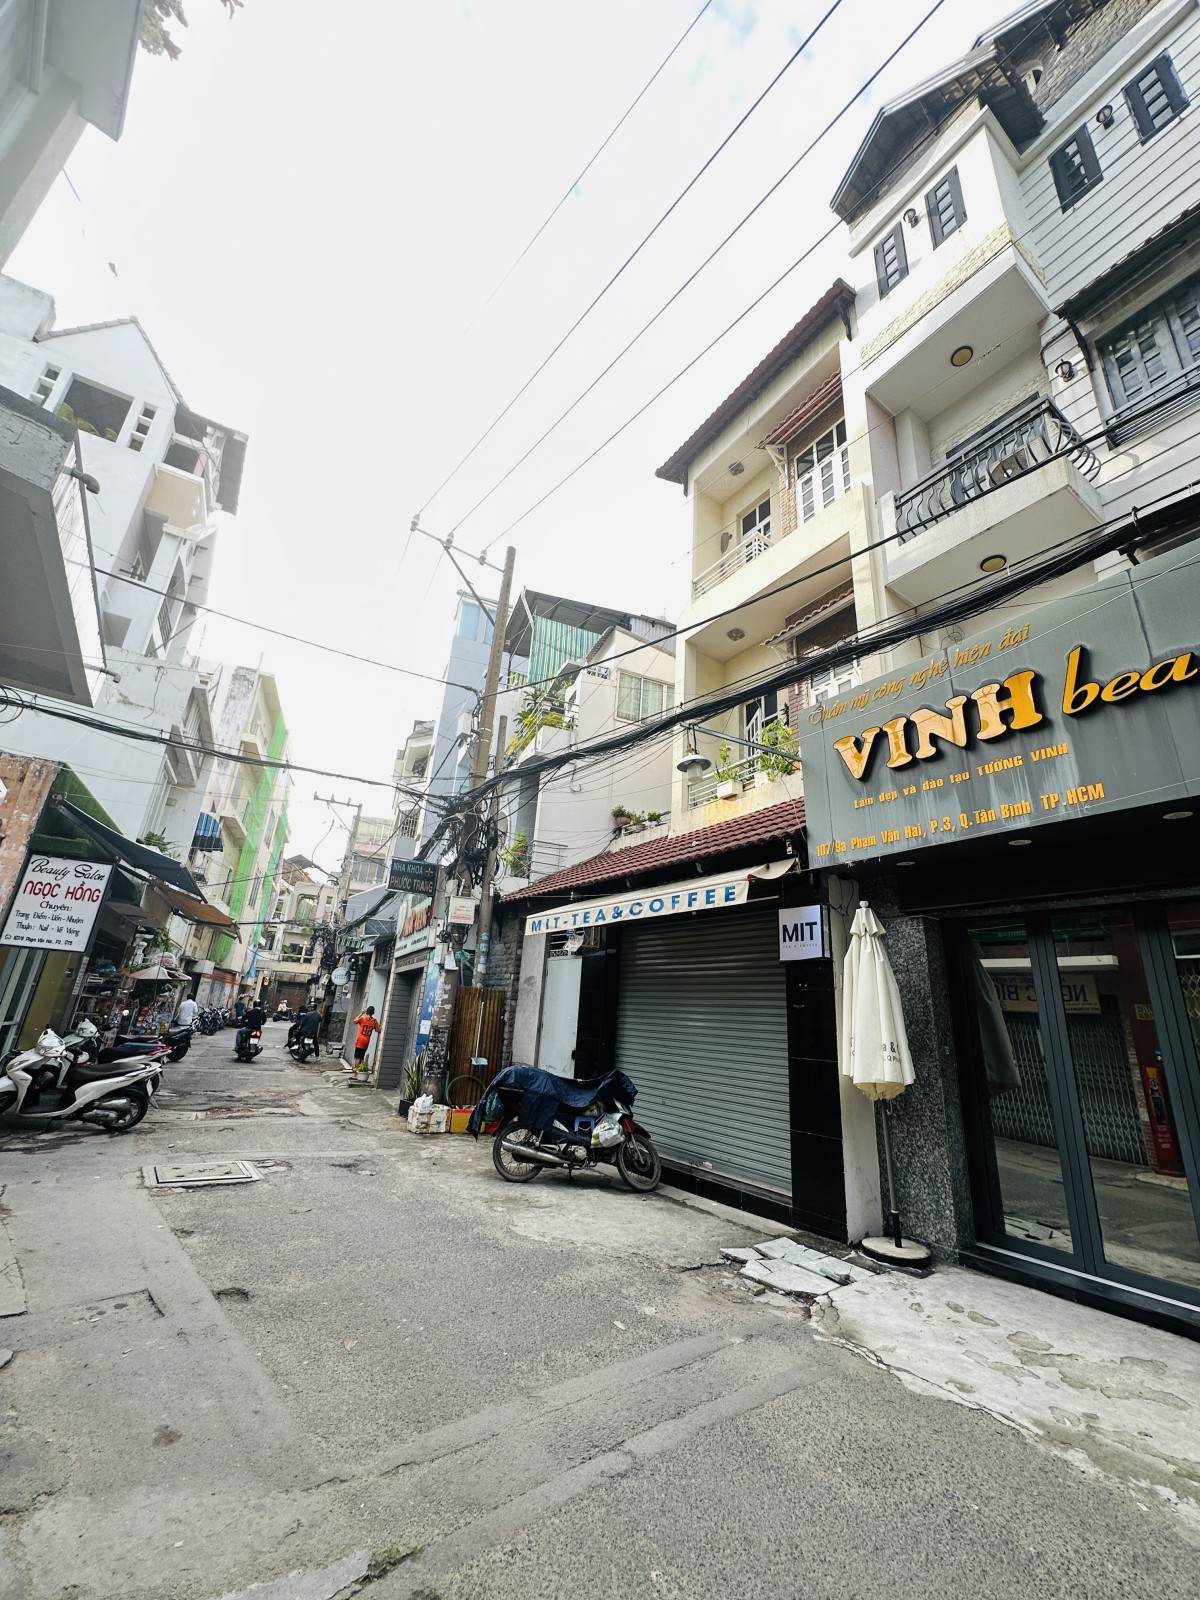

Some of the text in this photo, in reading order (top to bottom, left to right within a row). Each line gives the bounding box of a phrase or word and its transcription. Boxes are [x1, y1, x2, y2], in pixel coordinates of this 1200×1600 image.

[851, 688, 871, 712] mỹ
[872, 676, 906, 700] công
[908, 656, 949, 690] nghệ
[953, 641, 992, 669] hiện
[998, 622, 1031, 650] đại
[832, 670, 1044, 781] VINH
[853, 741, 1070, 810] Làm đẹp và đào tạo TƯỜNG VINH
[815, 840, 847, 857] 107/9a
[851, 834, 877, 850] Phạm
[881, 828, 900, 844] Văn
[1000, 799, 1032, 819] Bình
[31, 858, 106, 881] Beauty Salon
[392, 862, 424, 875] NHA KHOA
[23, 880, 101, 903] NGỌC HỒNG
[389, 874, 434, 893] PHƯỚC TRANG
[15, 909, 31, 921] Trang
[39, 900, 73, 912] Chuyên:
[782, 921, 818, 943] MIT
